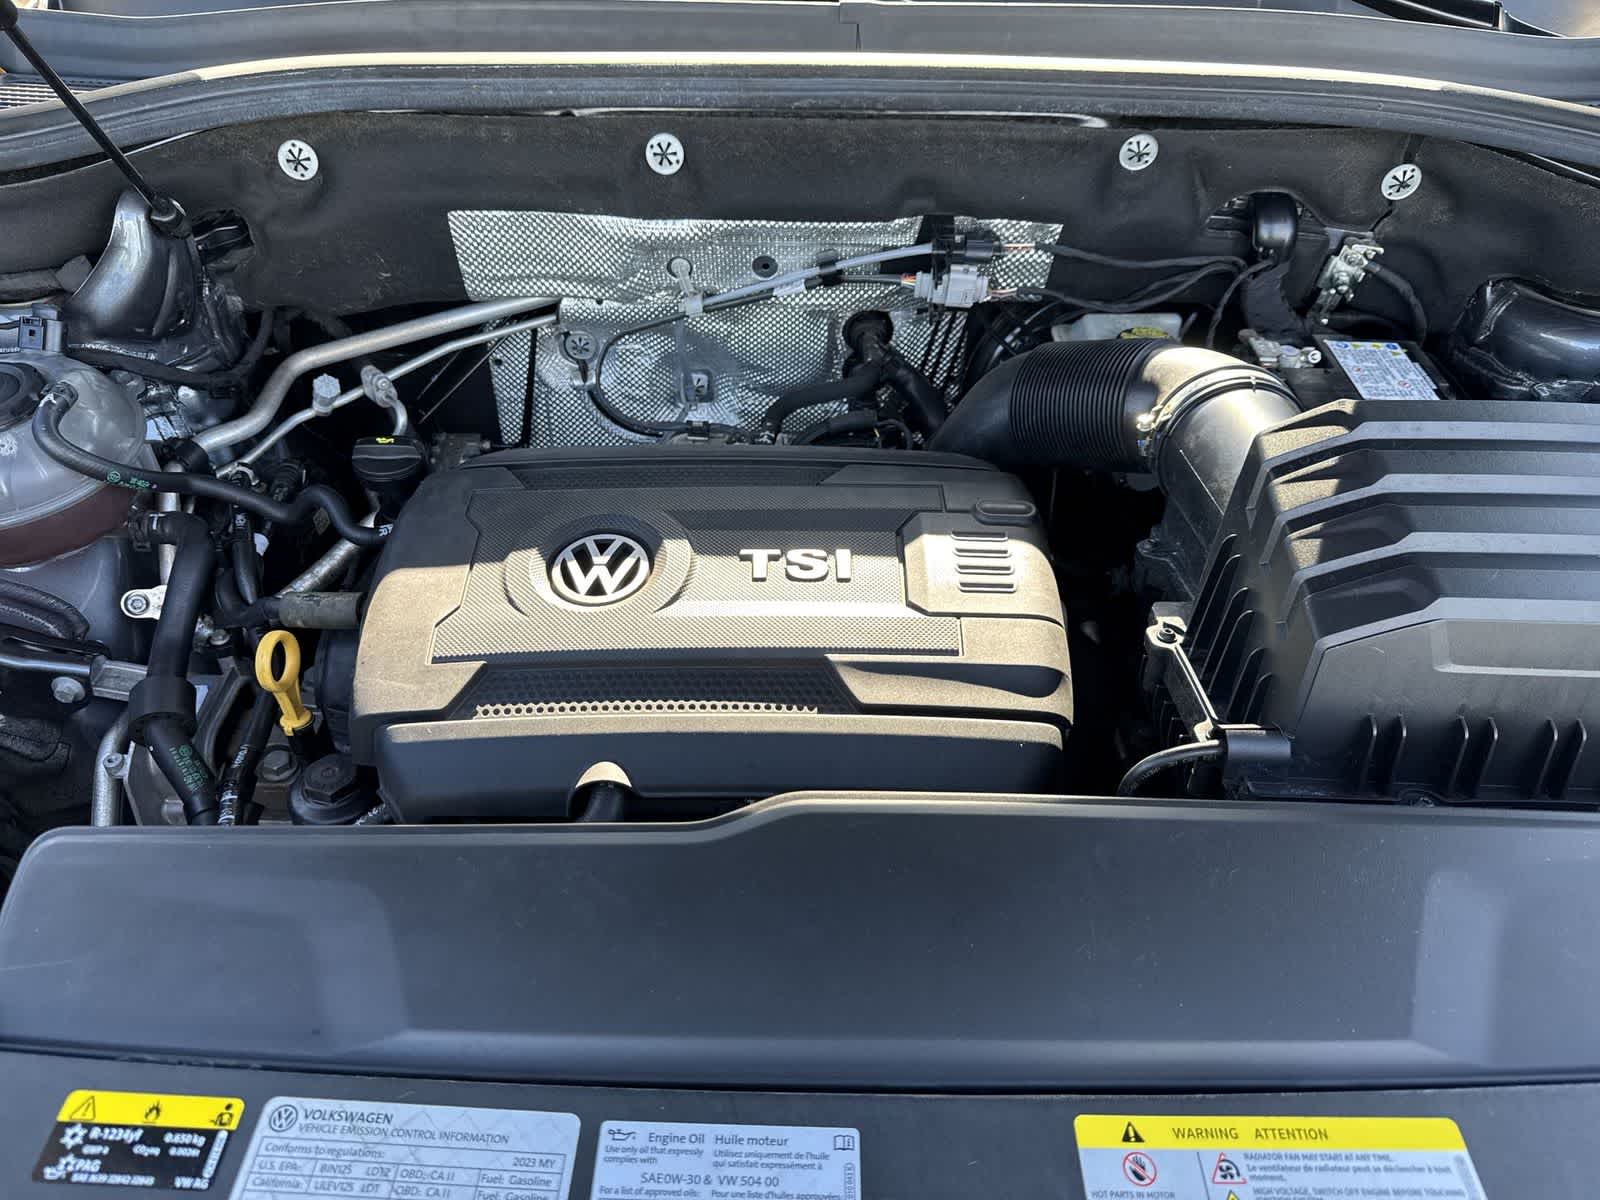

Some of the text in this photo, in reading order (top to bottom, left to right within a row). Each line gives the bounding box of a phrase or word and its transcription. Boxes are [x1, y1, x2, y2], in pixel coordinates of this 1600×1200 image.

[739, 548, 852, 583] TSI
[304, 1109, 394, 1125] VOLKSWAGEN
[298, 1123, 510, 1144] VEHICLE EMISSION CONTROL INFORMATION
[648, 1132, 705, 1146] Engine Oil
[1172, 1127, 1329, 1141] WARNING ATTENTION
[714, 1134, 788, 1147] Huile moteur
[265, 1142, 384, 1160] Conforms to regulations:
[621, 1146, 638, 1155] only
[639, 1146, 649, 1154] oil
[650, 1146, 666, 1154] that
[667, 1147, 704, 1157] expressly
[713, 1149, 830, 1161] Utilisez uniquement de l'huile
[512, 1156, 556, 1169] 2023 MY
[639, 1156, 658, 1164] with
[712, 1160, 725, 1169] qui
[728, 1160, 759, 1169] satisfait
[760, 1161, 816, 1171] expressément
[1259, 1164, 1301, 1173] ventilateur
[1303, 1164, 1313, 1173] de
[1314, 1164, 1350, 1173] radiateur
[1352, 1165, 1370, 1175] peut
[481, 1173, 552, 1187] Fuel: Gasoline
[703, 1174, 712, 1185] &
[718, 1175, 738, 1186] VW
[740, 1175, 762, 1187] 504
[764, 1176, 779, 1188] 00
[599, 1185, 614, 1194] For
[614, 1187, 619, 1195] a
[621, 1186, 633, 1195] list
[634, 1187, 644, 1195] of
[645, 1187, 682, 1198] approved
[711, 1189, 729, 1198] Pour
[730, 1191, 746, 1199] une
[746, 1190, 763, 1199] liste
[1091, 1190, 1176, 1200] HOT PARTS IN MOTOR
